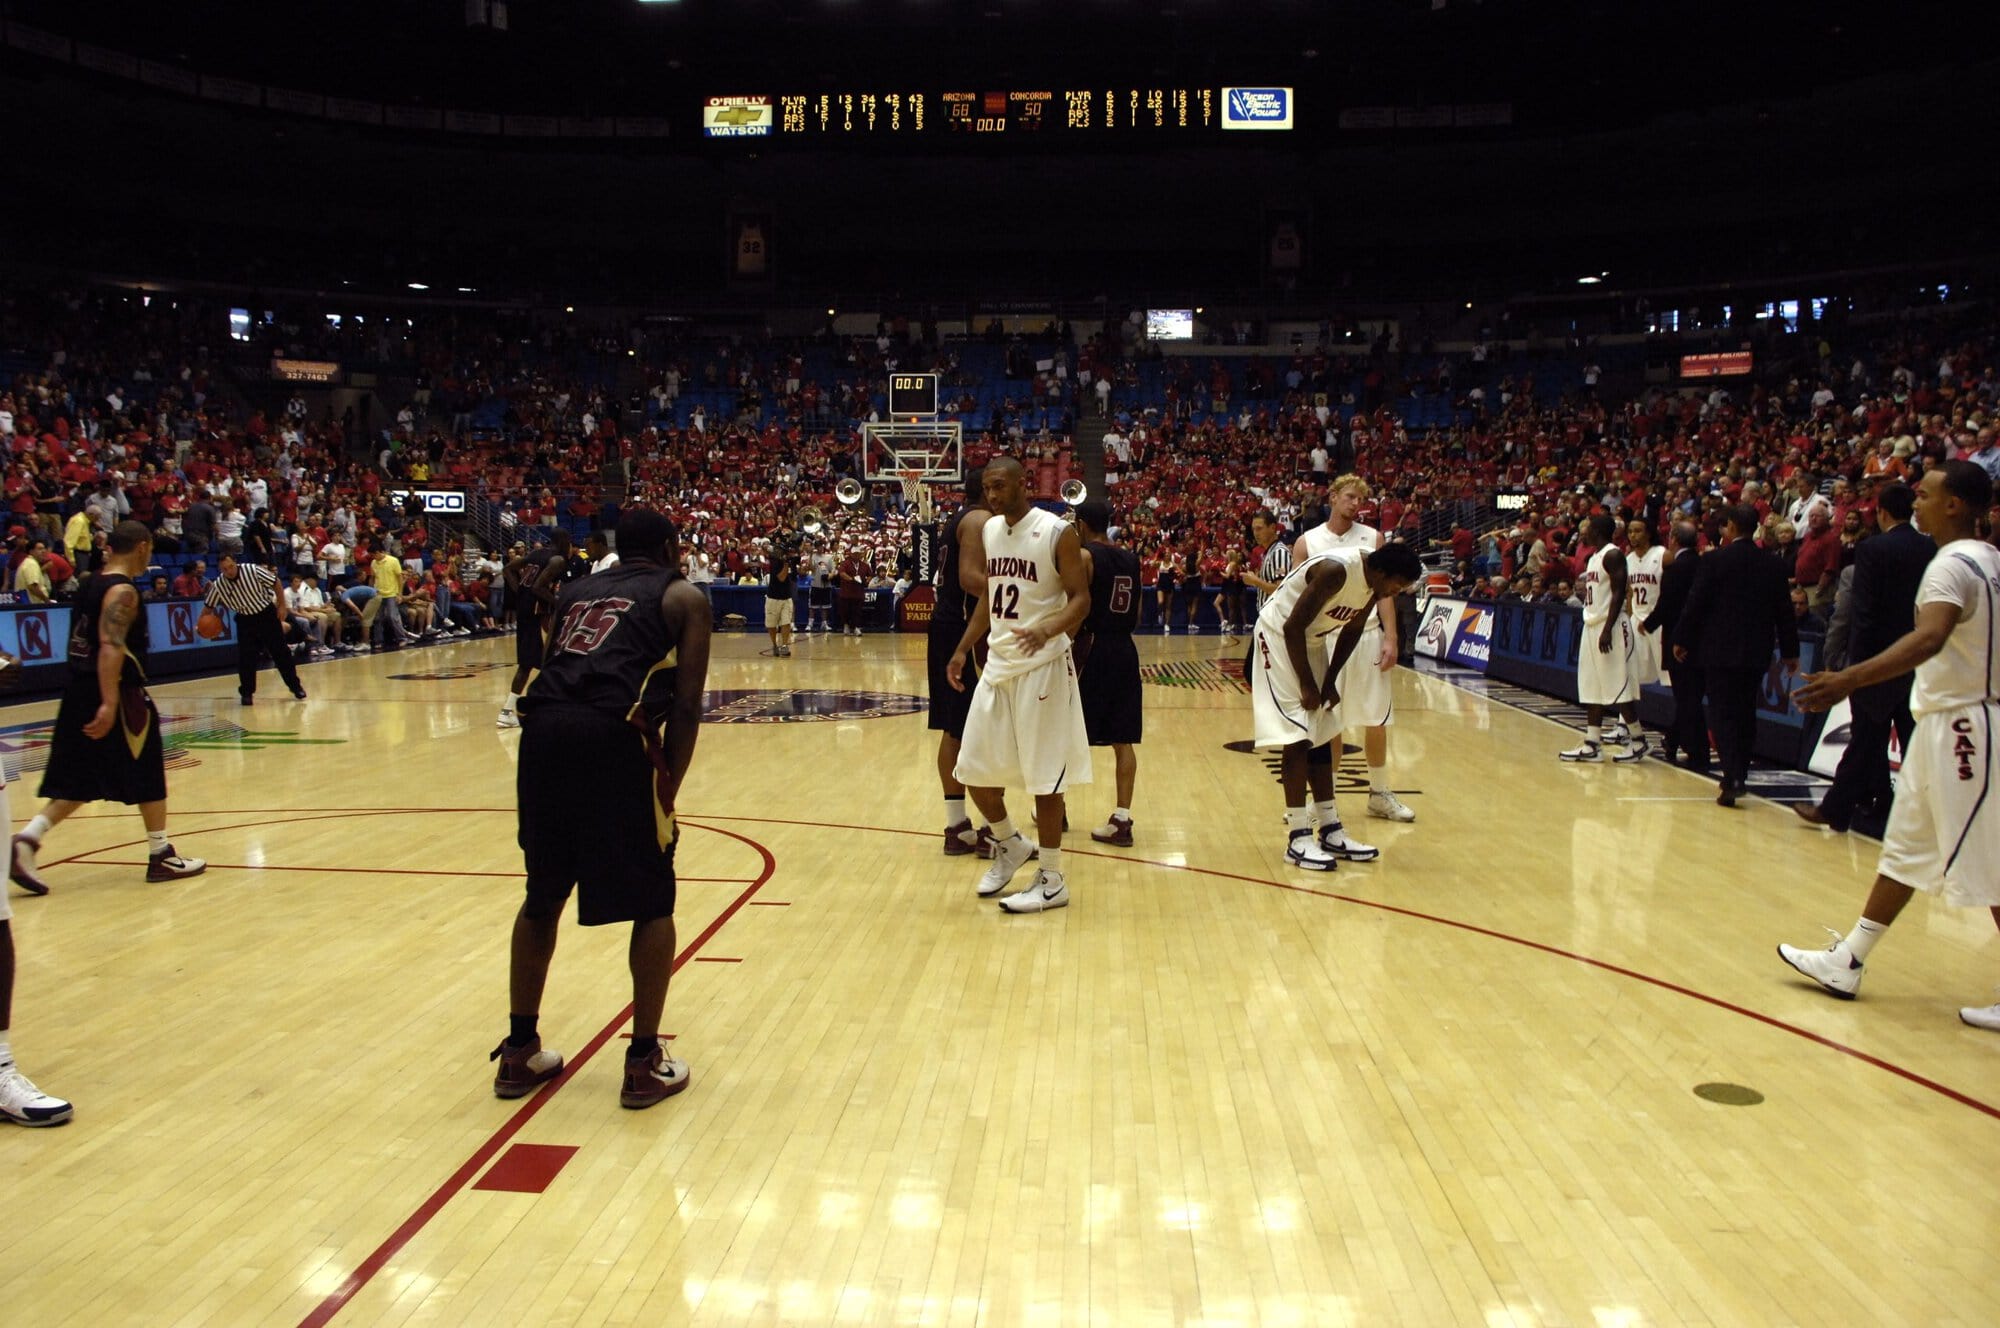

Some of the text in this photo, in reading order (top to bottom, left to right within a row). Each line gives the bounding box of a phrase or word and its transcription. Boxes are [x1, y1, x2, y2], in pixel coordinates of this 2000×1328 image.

[942, 91, 1052, 102] ARIZONA CONCORDIA
[1066, 91, 1091, 100] PLYR
[1242, 92, 1275, 102] Tucson
[710, 96, 766, 106] O'RIELLY
[781, 96, 807, 106] PLYR
[1070, 100, 1088, 109] PTS
[1246, 99, 1281, 109] Electric
[786, 105, 804, 114] PTS
[1249, 108, 1281, 117] Power
[976, 118, 1006, 132] 00.0
[710, 126, 767, 136] WATSON
[896, 378, 923, 390] 00.0
[920, 528, 929, 582] ARIZONA
[1110, 576, 1132, 614] 6
[1634, 587, 1648, 606] 12
[992, 584, 1020, 620] 42
[554, 597, 635, 657] 15
[1952, 718, 1976, 781] CATS
